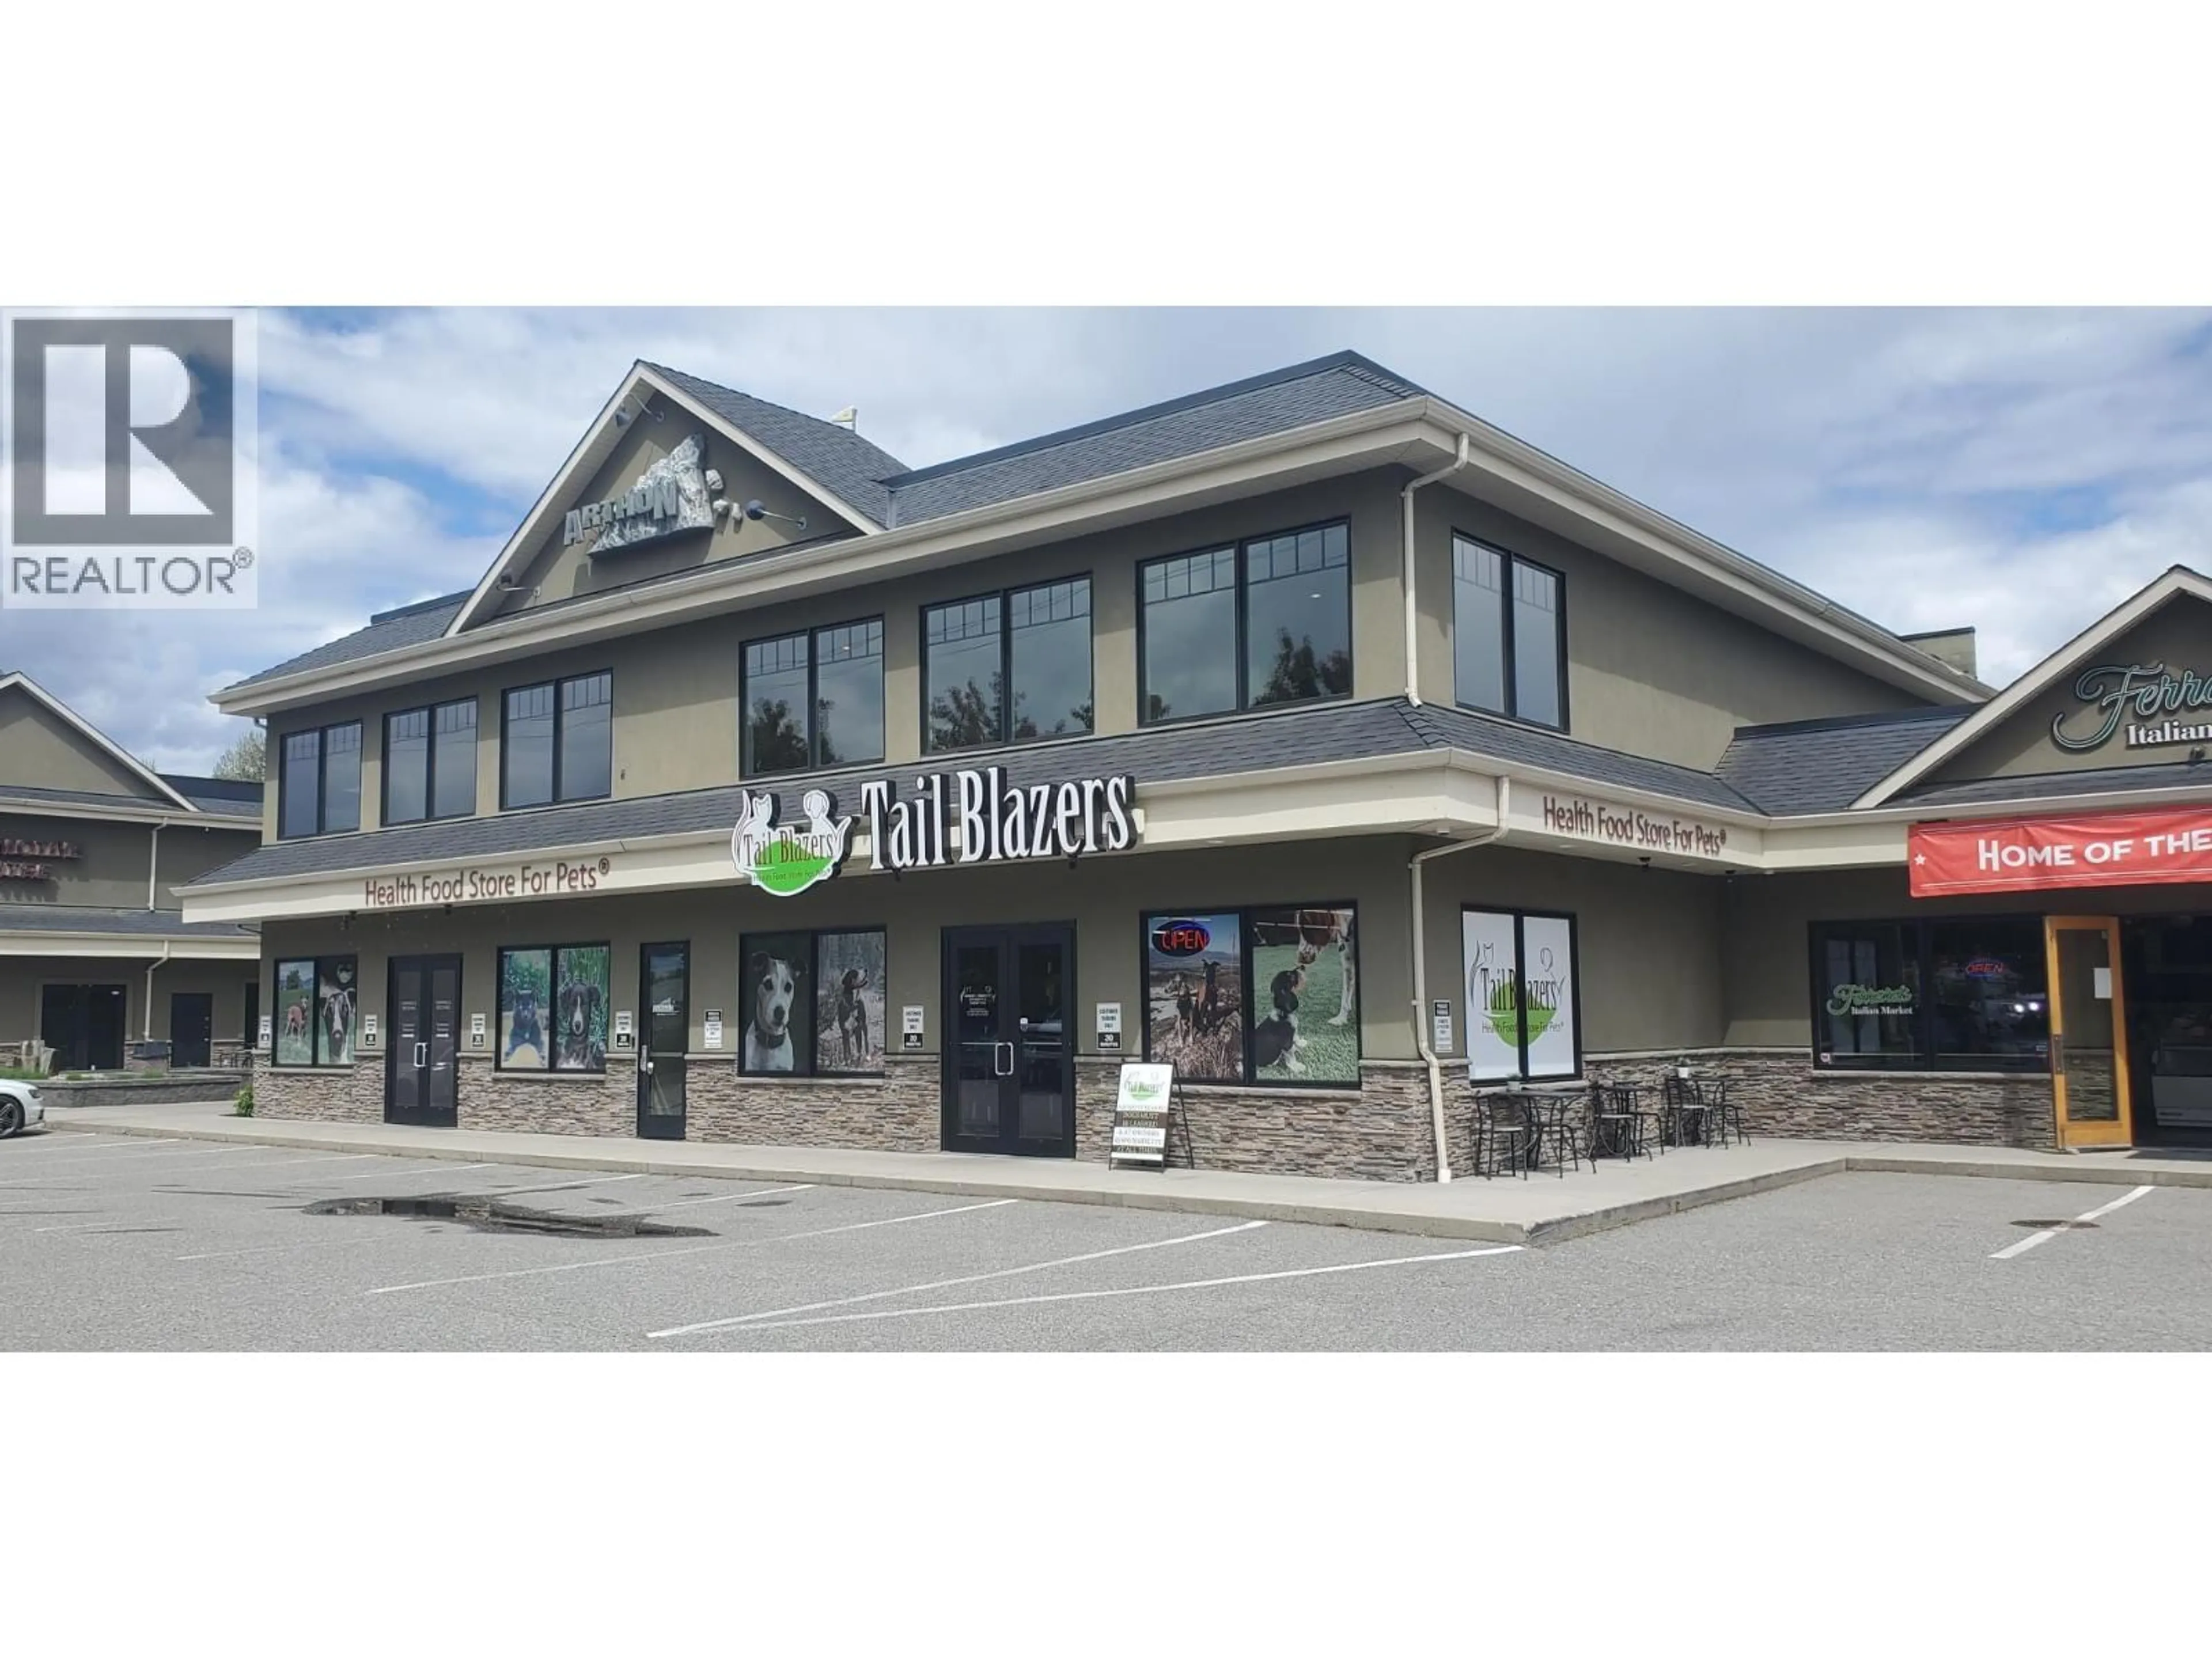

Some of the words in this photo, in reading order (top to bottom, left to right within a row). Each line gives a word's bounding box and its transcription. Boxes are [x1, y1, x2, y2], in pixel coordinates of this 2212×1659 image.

[564, 483, 678, 546] ARTHON
[2127, 721, 2212, 745] Italian
[861, 774, 945, 870] Tail
[956, 767, 1127, 863] Blazers
[1543, 796, 1594, 834] Health
[1598, 807, 1634, 840] Food
[1636, 814, 1671, 846] Store
[1673, 820, 1693, 849] For
[744, 832, 772, 866] Tail
[779, 830, 834, 863] Blazers
[1978, 839, 2076, 872] HOME
[2084, 840, 2134, 864] OF
[2143, 828, 2212, 857] THE
[366, 875, 417, 906] Health
[422, 869, 464, 902] Food
[469, 870, 516, 898] Store
[521, 866, 551, 893] For
[1162, 930, 1207, 951] OPEN
[1480, 968, 1507, 1010] Tail
[1508, 968, 1557, 1010] Bazers
[1851, 1006, 1880, 1015] Italian
[1880, 1006, 1913, 1014] Market
